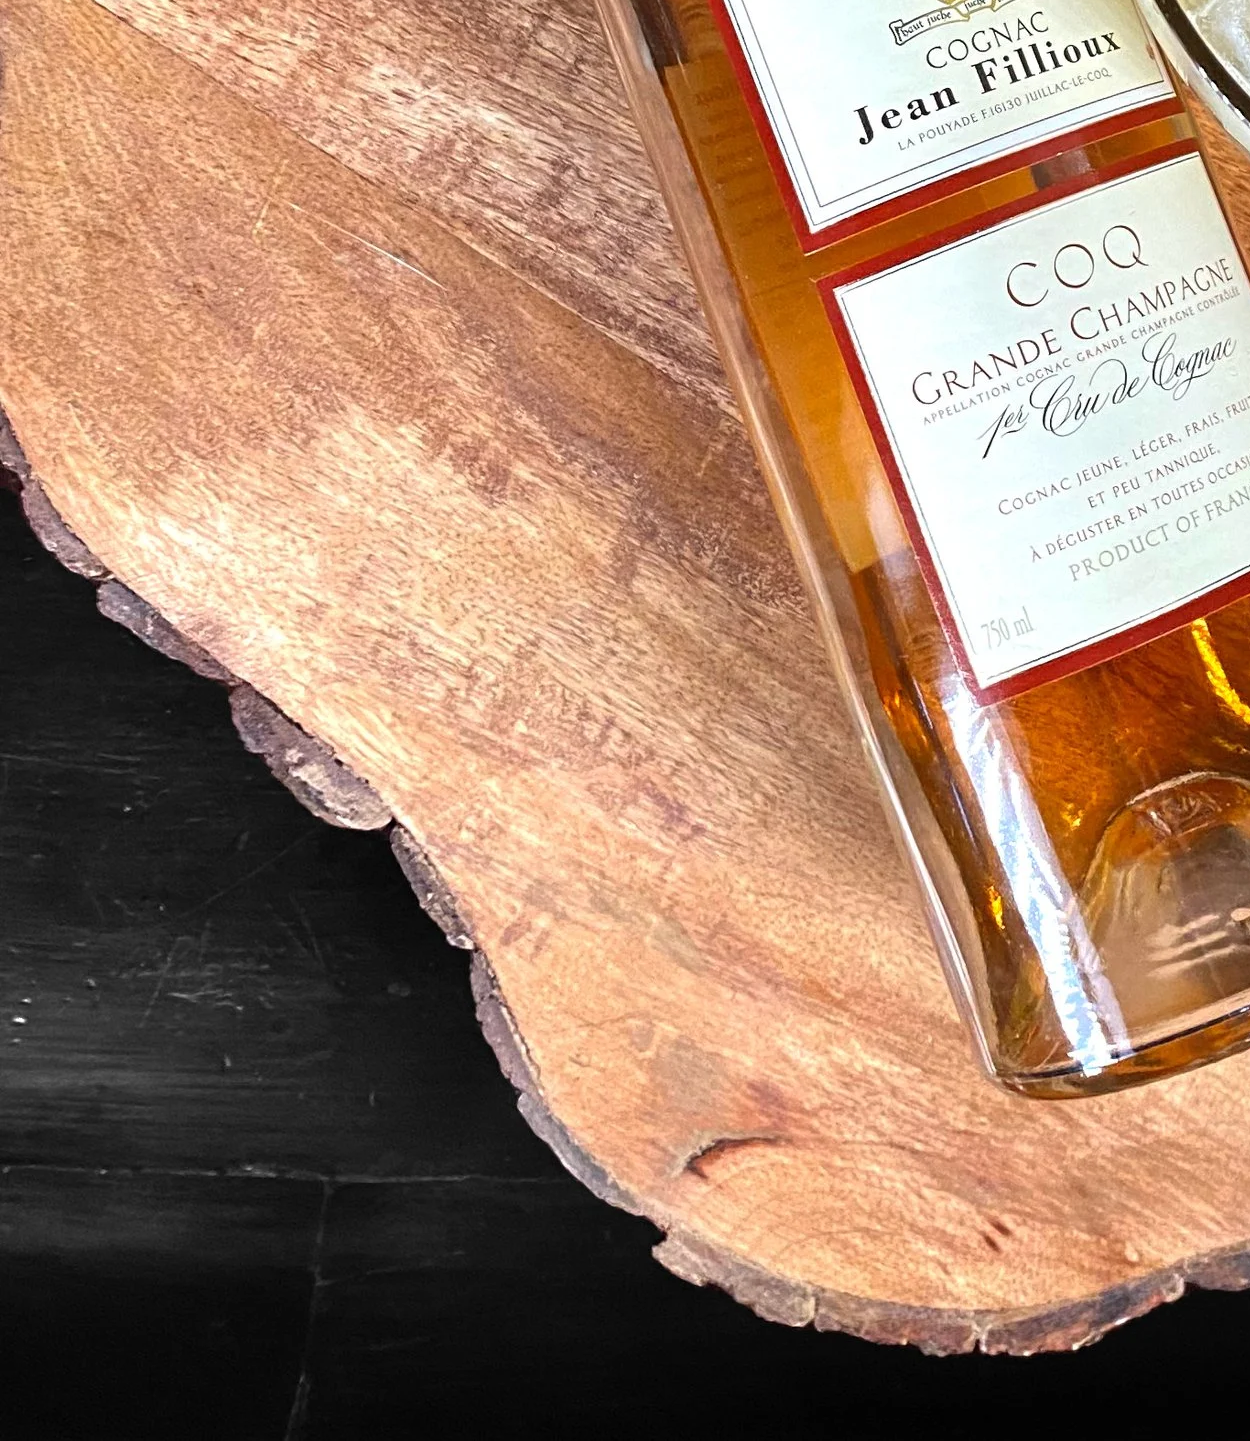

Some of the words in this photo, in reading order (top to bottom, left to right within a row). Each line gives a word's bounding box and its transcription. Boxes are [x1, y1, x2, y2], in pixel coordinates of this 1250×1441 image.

[926, 11, 1049, 69] COGNAC
[854, 86, 960, 145] Jean
[971, 31, 1121, 95] Fillioux
[898, 138, 915, 151] LA
[918, 113, 979, 144] POUYADE
[1025, 67, 1113, 105] JUILLAC-LE-COQ
[1006, 225, 1149, 307] COQ
[912, 328, 1063, 405] GRANDE
[1070, 258, 1234, 340] CHAMPAGNE
[923, 382, 1011, 426] APPELLATION
[1016, 357, 1072, 388] COGNAC
[1076, 335, 1128, 363] GRANDE
[1131, 305, 1196, 340] CHAMPAGNE
[977, 403, 1031, 459] 1er
[1029, 374, 1110, 437] Cru
[1089, 358, 1149, 405] de
[1142, 332, 1237, 401] Cognac
[998, 477, 1073, 515] COGNAC
[1076, 455, 1129, 486] JEUNE,
[1131, 433, 1183, 461] LÉGER,
[1087, 491, 1105, 509] ET
[1112, 478, 1141, 499] PEU
[1029, 545, 1042, 563] À
[1045, 514, 1126, 556] DÉGUSTER
[1128, 503, 1149, 521] EN
[1151, 477, 1205, 510] TOUTES
[1068, 523, 1170, 582] PRODUCT
[1176, 509, 1203, 533] OF
[980, 617, 1011, 650] 750
[1013, 605, 1035, 636] ml
